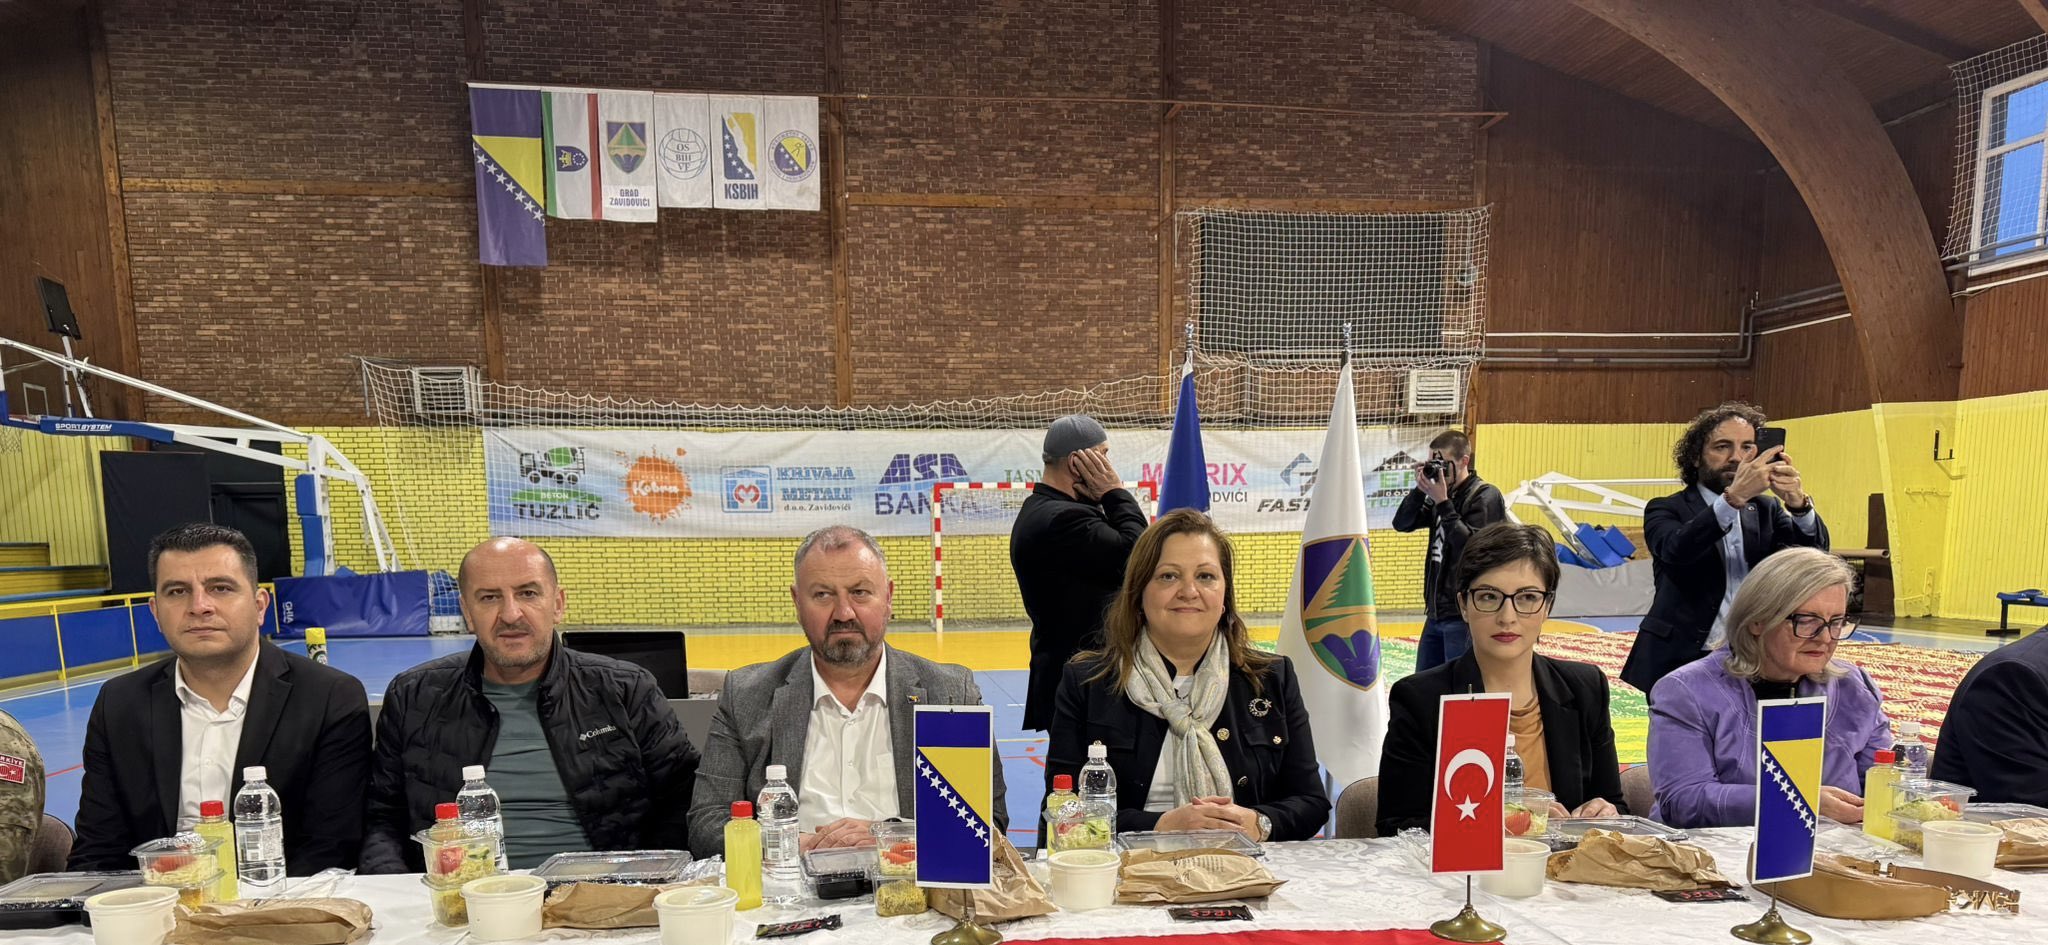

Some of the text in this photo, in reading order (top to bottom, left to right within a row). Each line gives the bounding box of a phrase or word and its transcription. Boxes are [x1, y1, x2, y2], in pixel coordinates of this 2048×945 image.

[676, 143, 690, 151] OS
[620, 189, 639, 197] GRAD
[724, 183, 759, 200] KSBIH
[776, 467, 856, 480] KRIVAJA
[879, 453, 968, 485] ASA
[1142, 463, 1248, 486] MRIX
[541, 492, 569, 500] BETON
[781, 488, 852, 501] METALI
